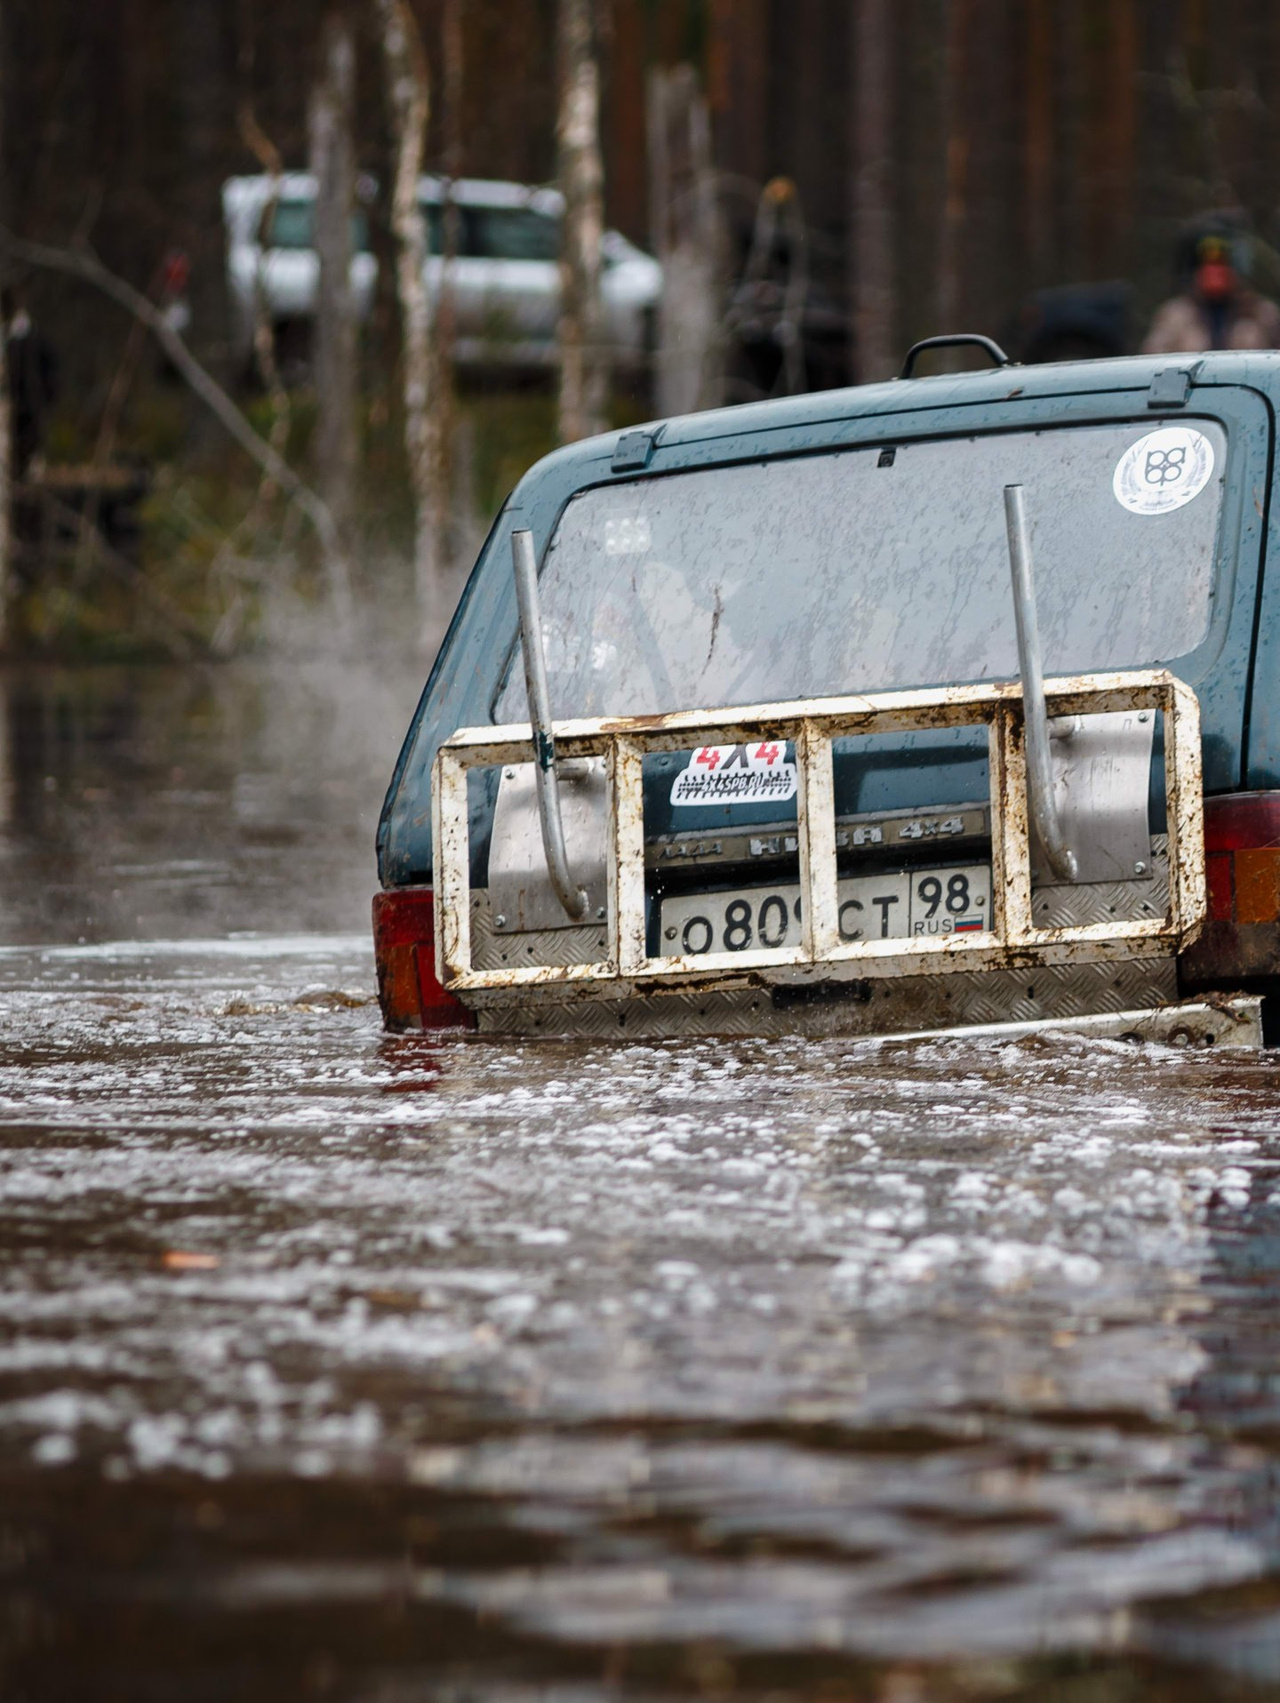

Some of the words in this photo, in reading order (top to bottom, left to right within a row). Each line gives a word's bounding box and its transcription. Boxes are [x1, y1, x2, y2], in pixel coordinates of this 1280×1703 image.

[701, 774, 765, 793] 4X4SPB.RU
[918, 873, 970, 919] 98
[914, 919, 952, 936] RUS
